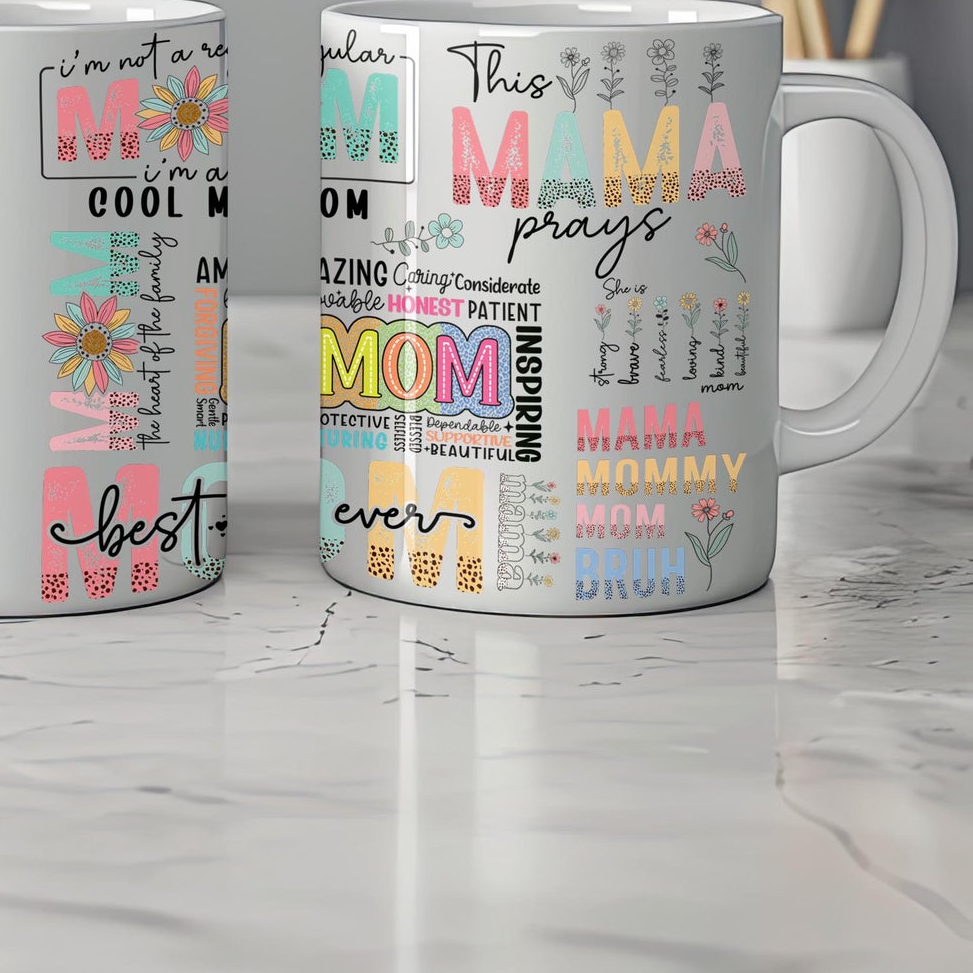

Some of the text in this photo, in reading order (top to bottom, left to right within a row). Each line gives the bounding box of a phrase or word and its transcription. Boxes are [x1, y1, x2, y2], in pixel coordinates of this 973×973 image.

[59, 48, 111, 78] i'm
[118, 32, 171, 80] not
[447, 40, 553, 103] This
[451, 102, 747, 210] MAMA
[87, 185, 183, 219] COOL
[506, 207, 672, 279] prays
[454, 273, 541, 294] Considerate
[602, 277, 631, 300] She
[136, 230, 178, 416] heart family
[467, 300, 542, 323] PATIENT
[617, 342, 641, 385] brave
[514, 324, 543, 463] INSPIRING
[576, 401, 707, 452] MAMA
[430, 443, 516, 462] BEAUTIFUL
[576, 452, 748, 496] MOMMY
[49, 478, 228, 567] best
[334, 503, 476, 533] ever
[575, 502, 666, 540] MOM
[575, 546, 686, 601] BRUH
